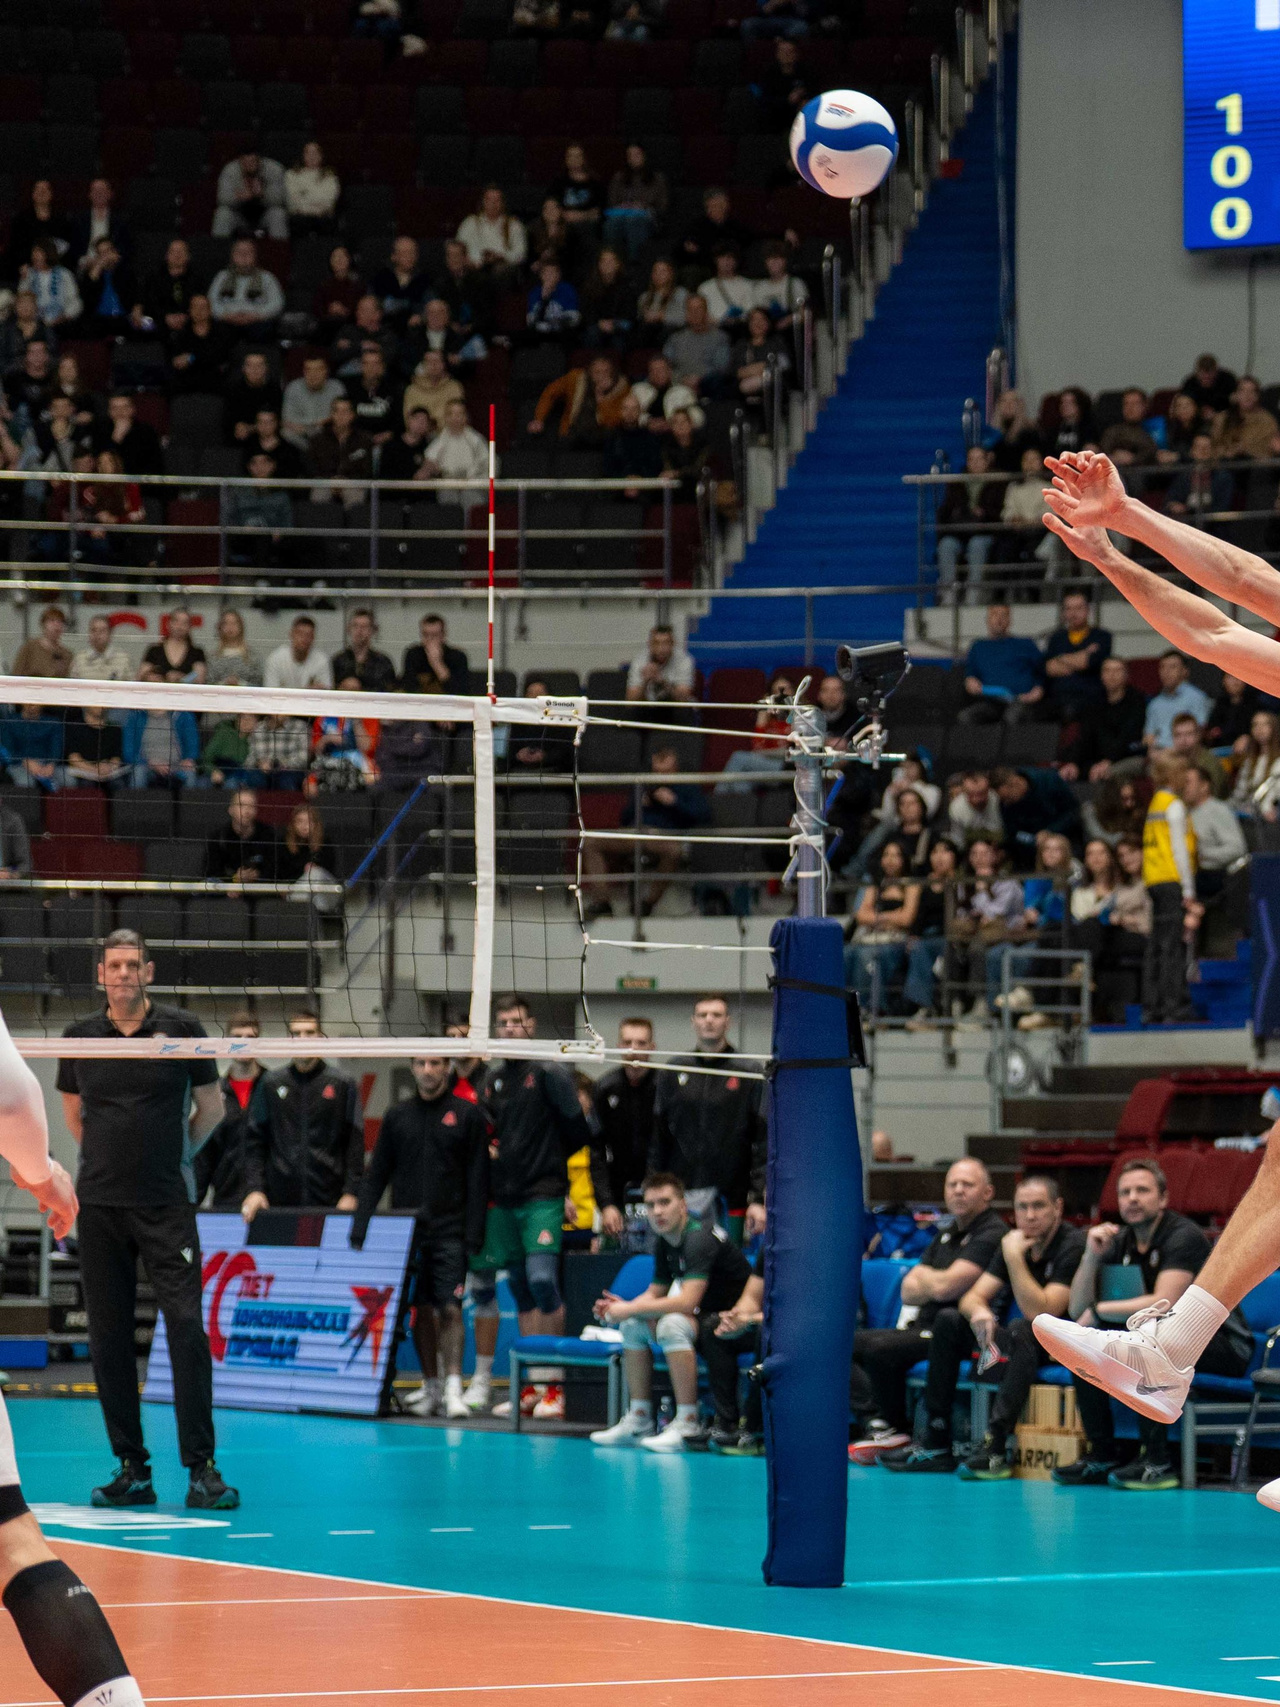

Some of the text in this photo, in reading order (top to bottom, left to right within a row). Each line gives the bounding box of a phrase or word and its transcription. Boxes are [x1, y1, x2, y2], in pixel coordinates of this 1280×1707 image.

[1216, 93, 1243, 135] 1
[1211, 145, 1252, 188] 0
[1211, 197, 1252, 240] 0
